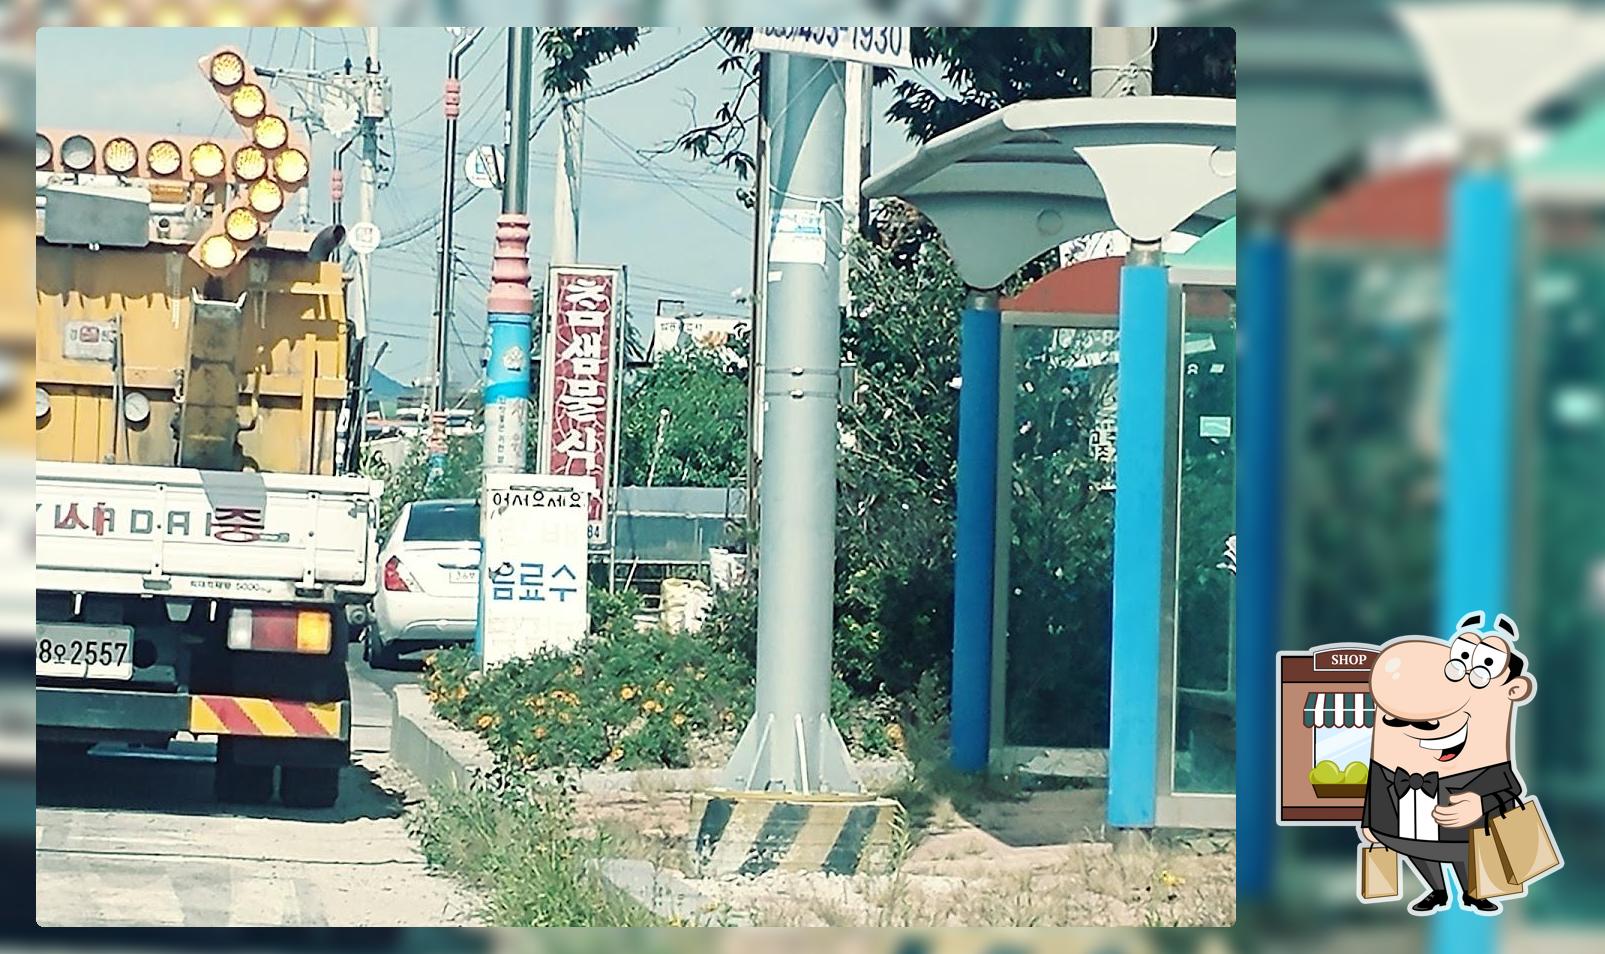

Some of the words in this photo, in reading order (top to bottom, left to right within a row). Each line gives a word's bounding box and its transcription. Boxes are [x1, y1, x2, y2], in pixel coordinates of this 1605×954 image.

[493, 491, 581, 508] 어서오세요
[489, 562, 577, 602] 음료수
[37, 639, 128, 667] 8오2557
